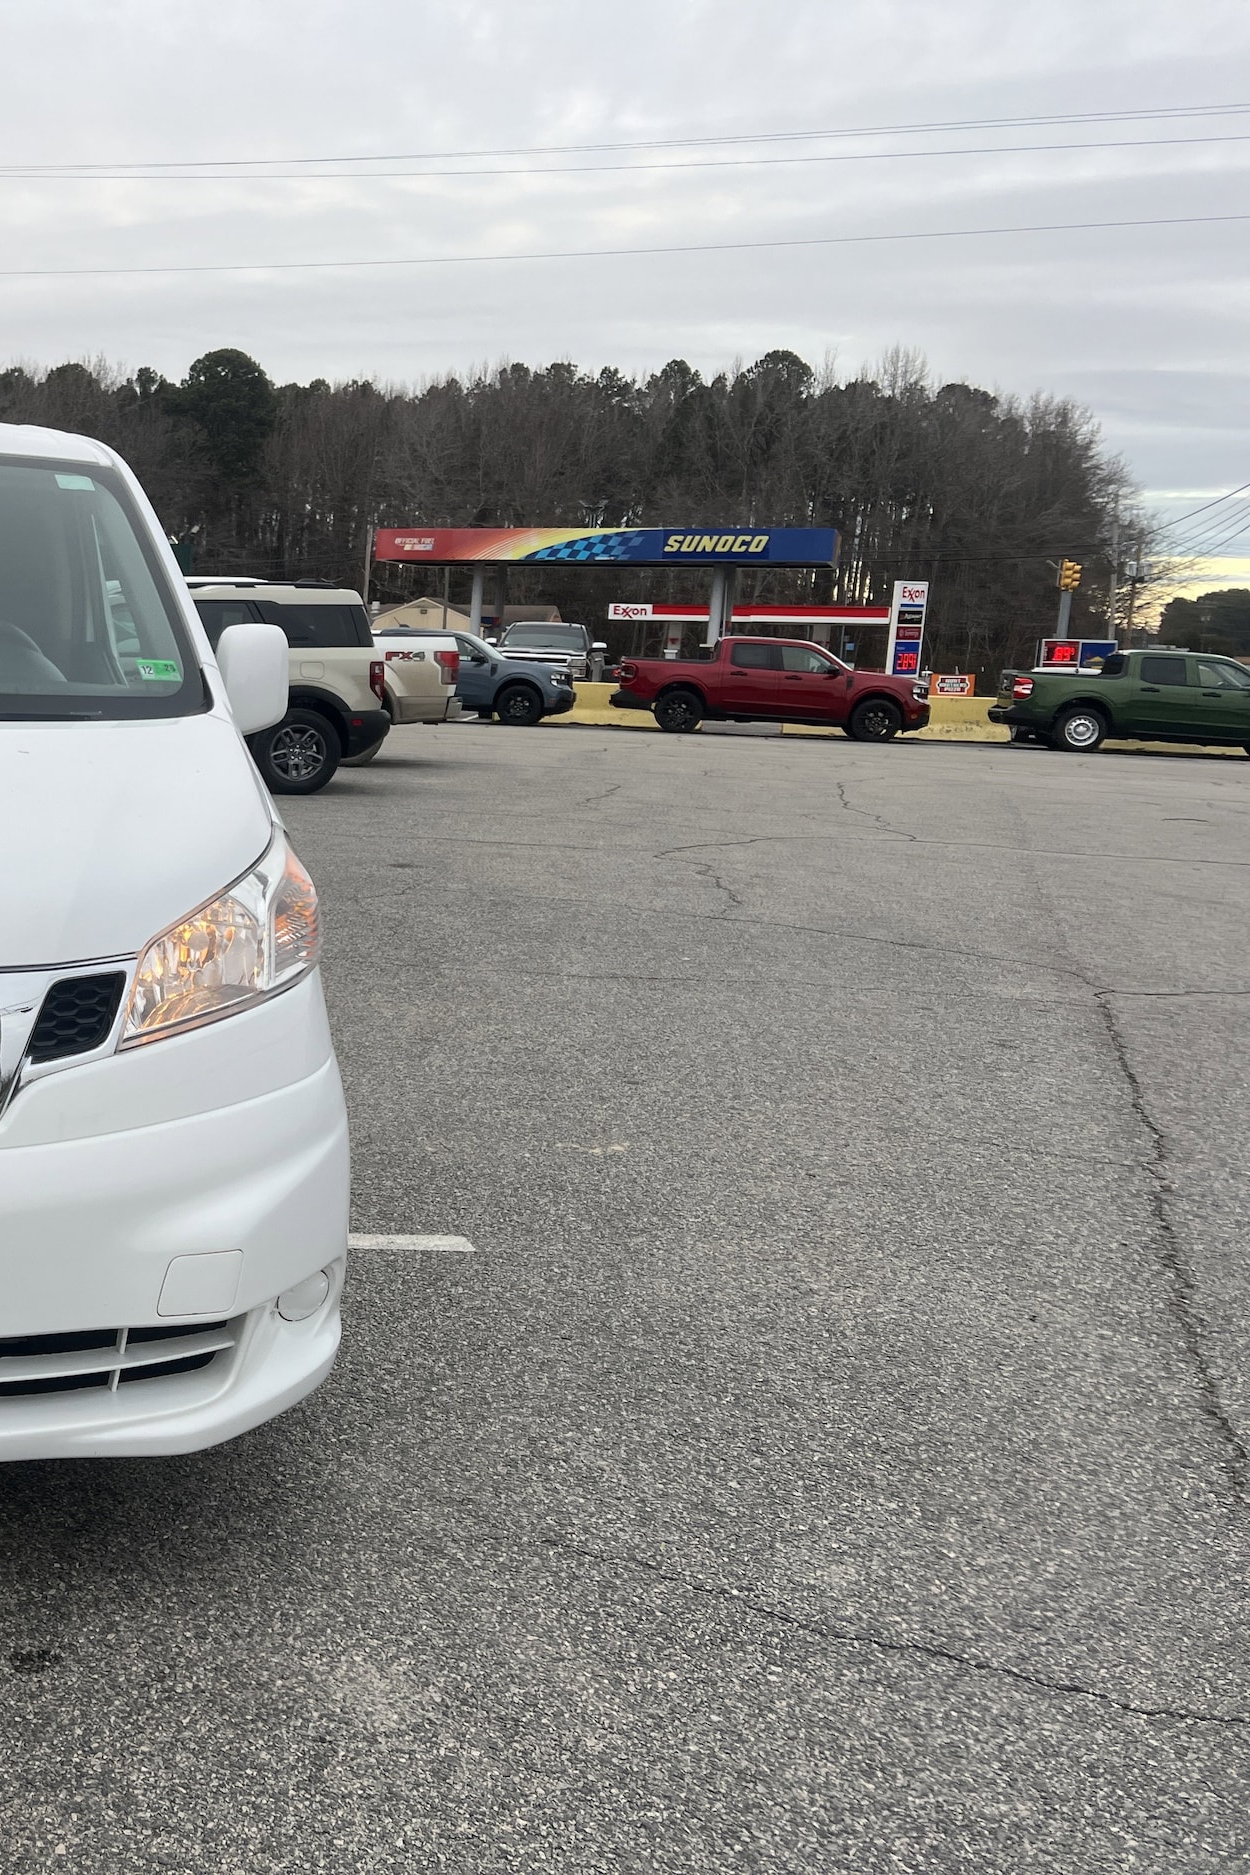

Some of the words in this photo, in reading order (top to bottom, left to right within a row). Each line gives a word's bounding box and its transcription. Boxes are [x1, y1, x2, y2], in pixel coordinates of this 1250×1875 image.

[663, 535, 770, 553] SUNOCO
[902, 586, 925, 603] Exxon
[613, 605, 647, 619] Exxon
[385, 651, 426, 662] FX4
[141, 665, 154, 675] 12
